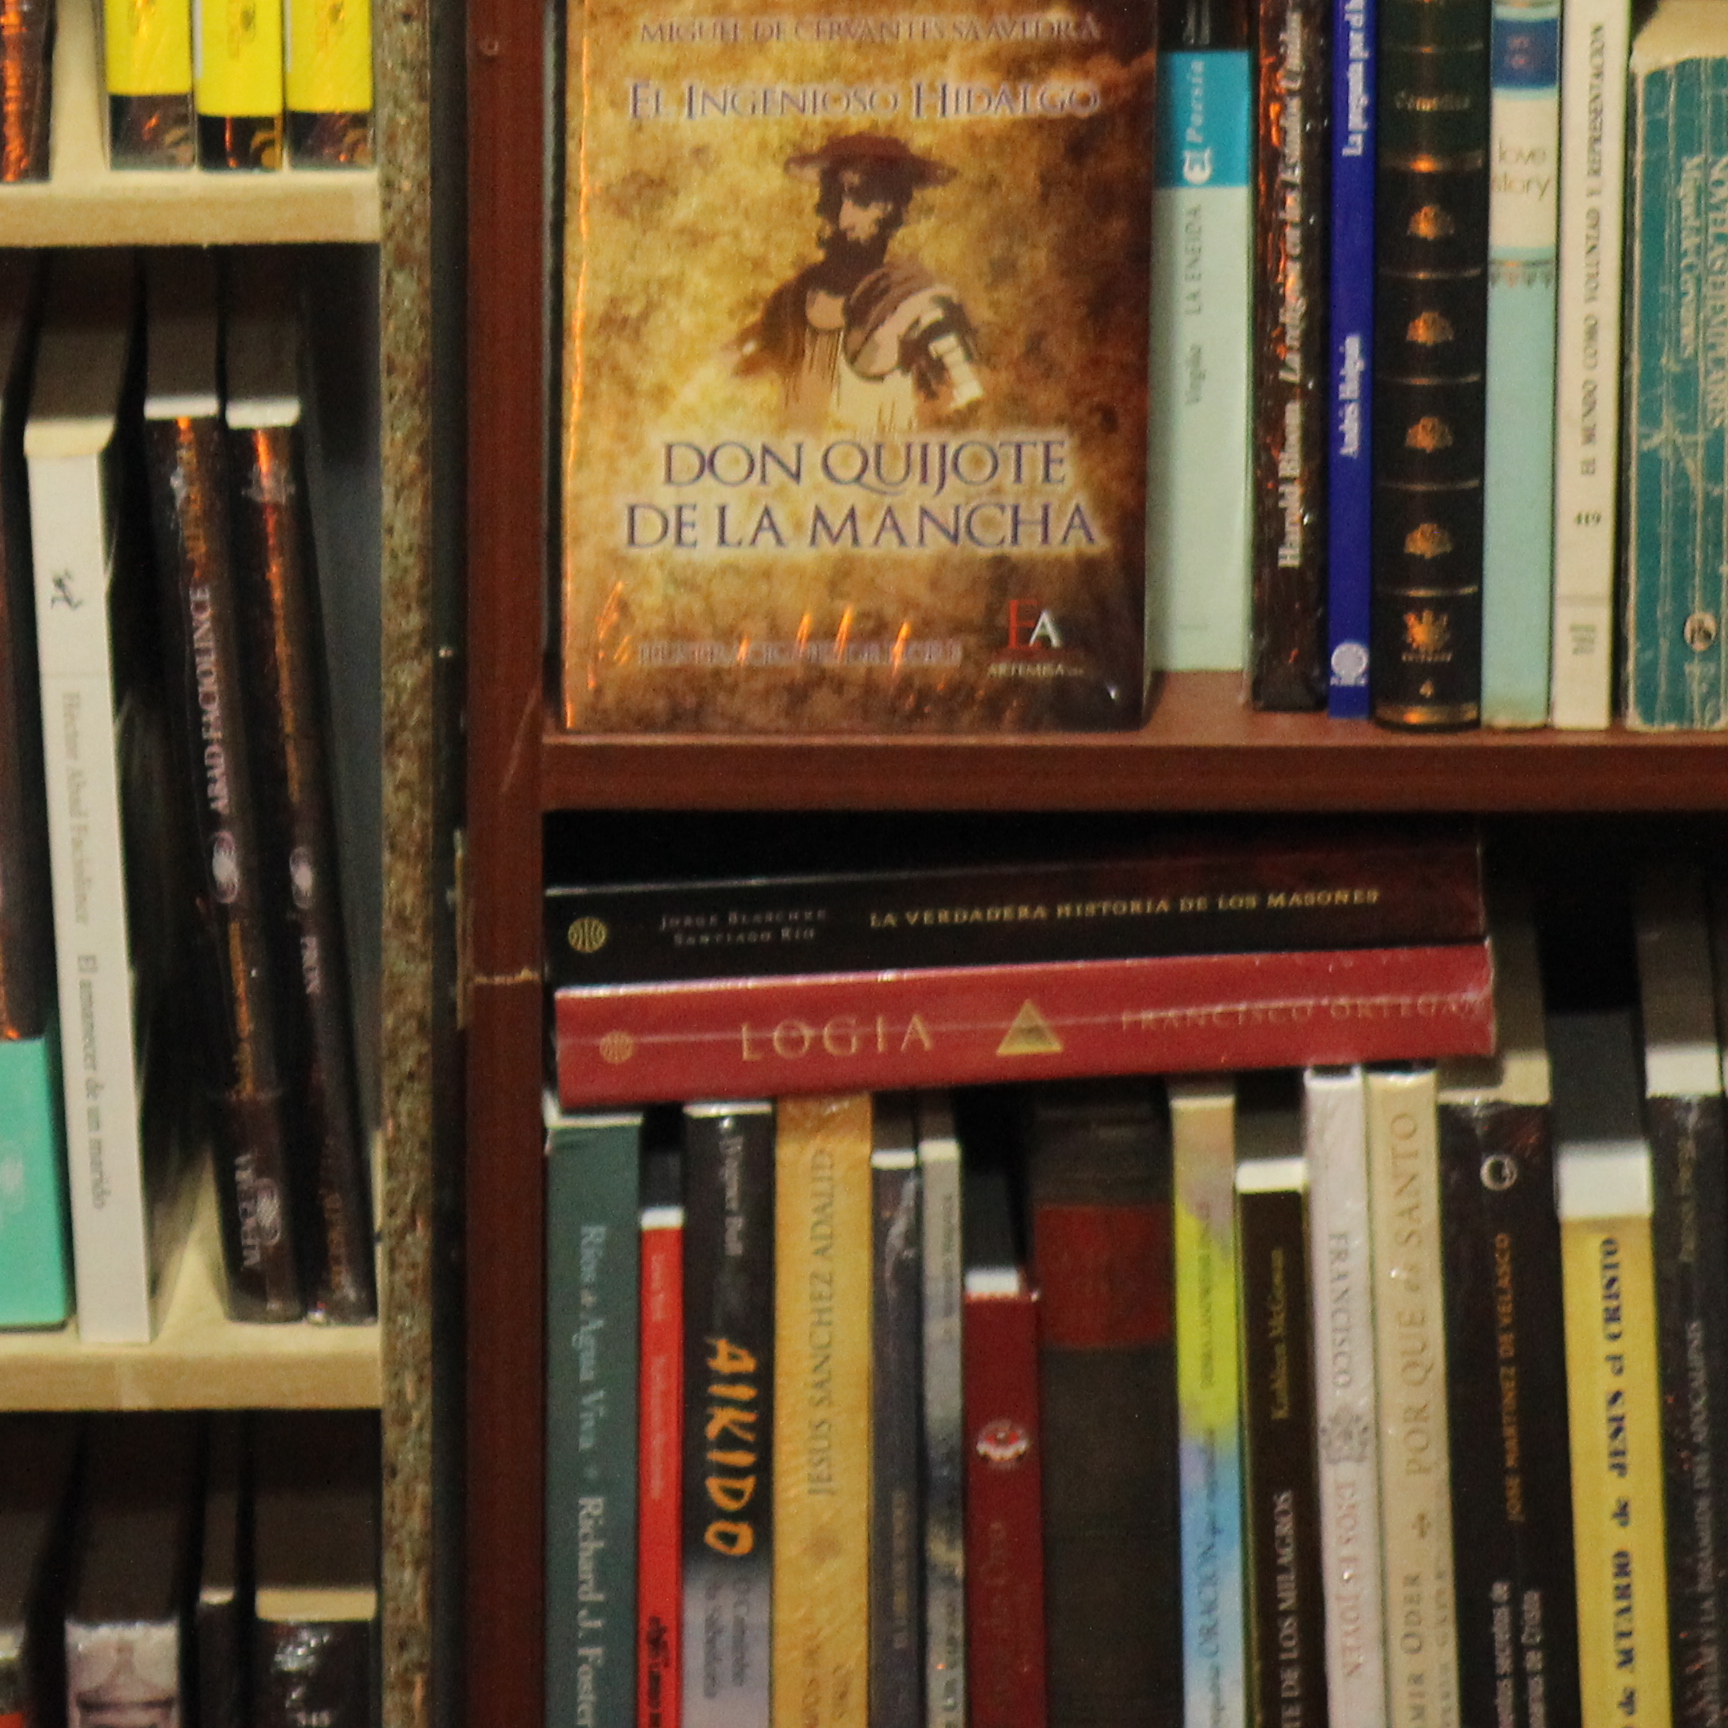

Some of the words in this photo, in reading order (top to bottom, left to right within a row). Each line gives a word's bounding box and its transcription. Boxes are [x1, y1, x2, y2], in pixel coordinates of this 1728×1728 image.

[640, 18, 740, 42] MIGUEL
[752, 18, 786, 42] DE
[793, 18, 944, 42] CERVANTES
[664, 439, 802, 487] DON
[821, 439, 1066, 496] QUIJOTE
[626, 503, 697, 549] DE
[716, 503, 785, 549] LA
[810, 503, 1097, 549] MANCHA
[871, 909, 897, 928] LA
[904, 906, 1048, 926] VERDADERA
[1058, 900, 1169, 920] HISTORIA
[1179, 896, 1207, 914] DE
[1216, 893, 1257, 912] LOS
[1267, 888, 1379, 909] MASONES
[743, 1014, 934, 1061] LOGIA
[705, 1338, 758, 1557] AIKIDO
[577, 1497, 604, 1606] Richard
